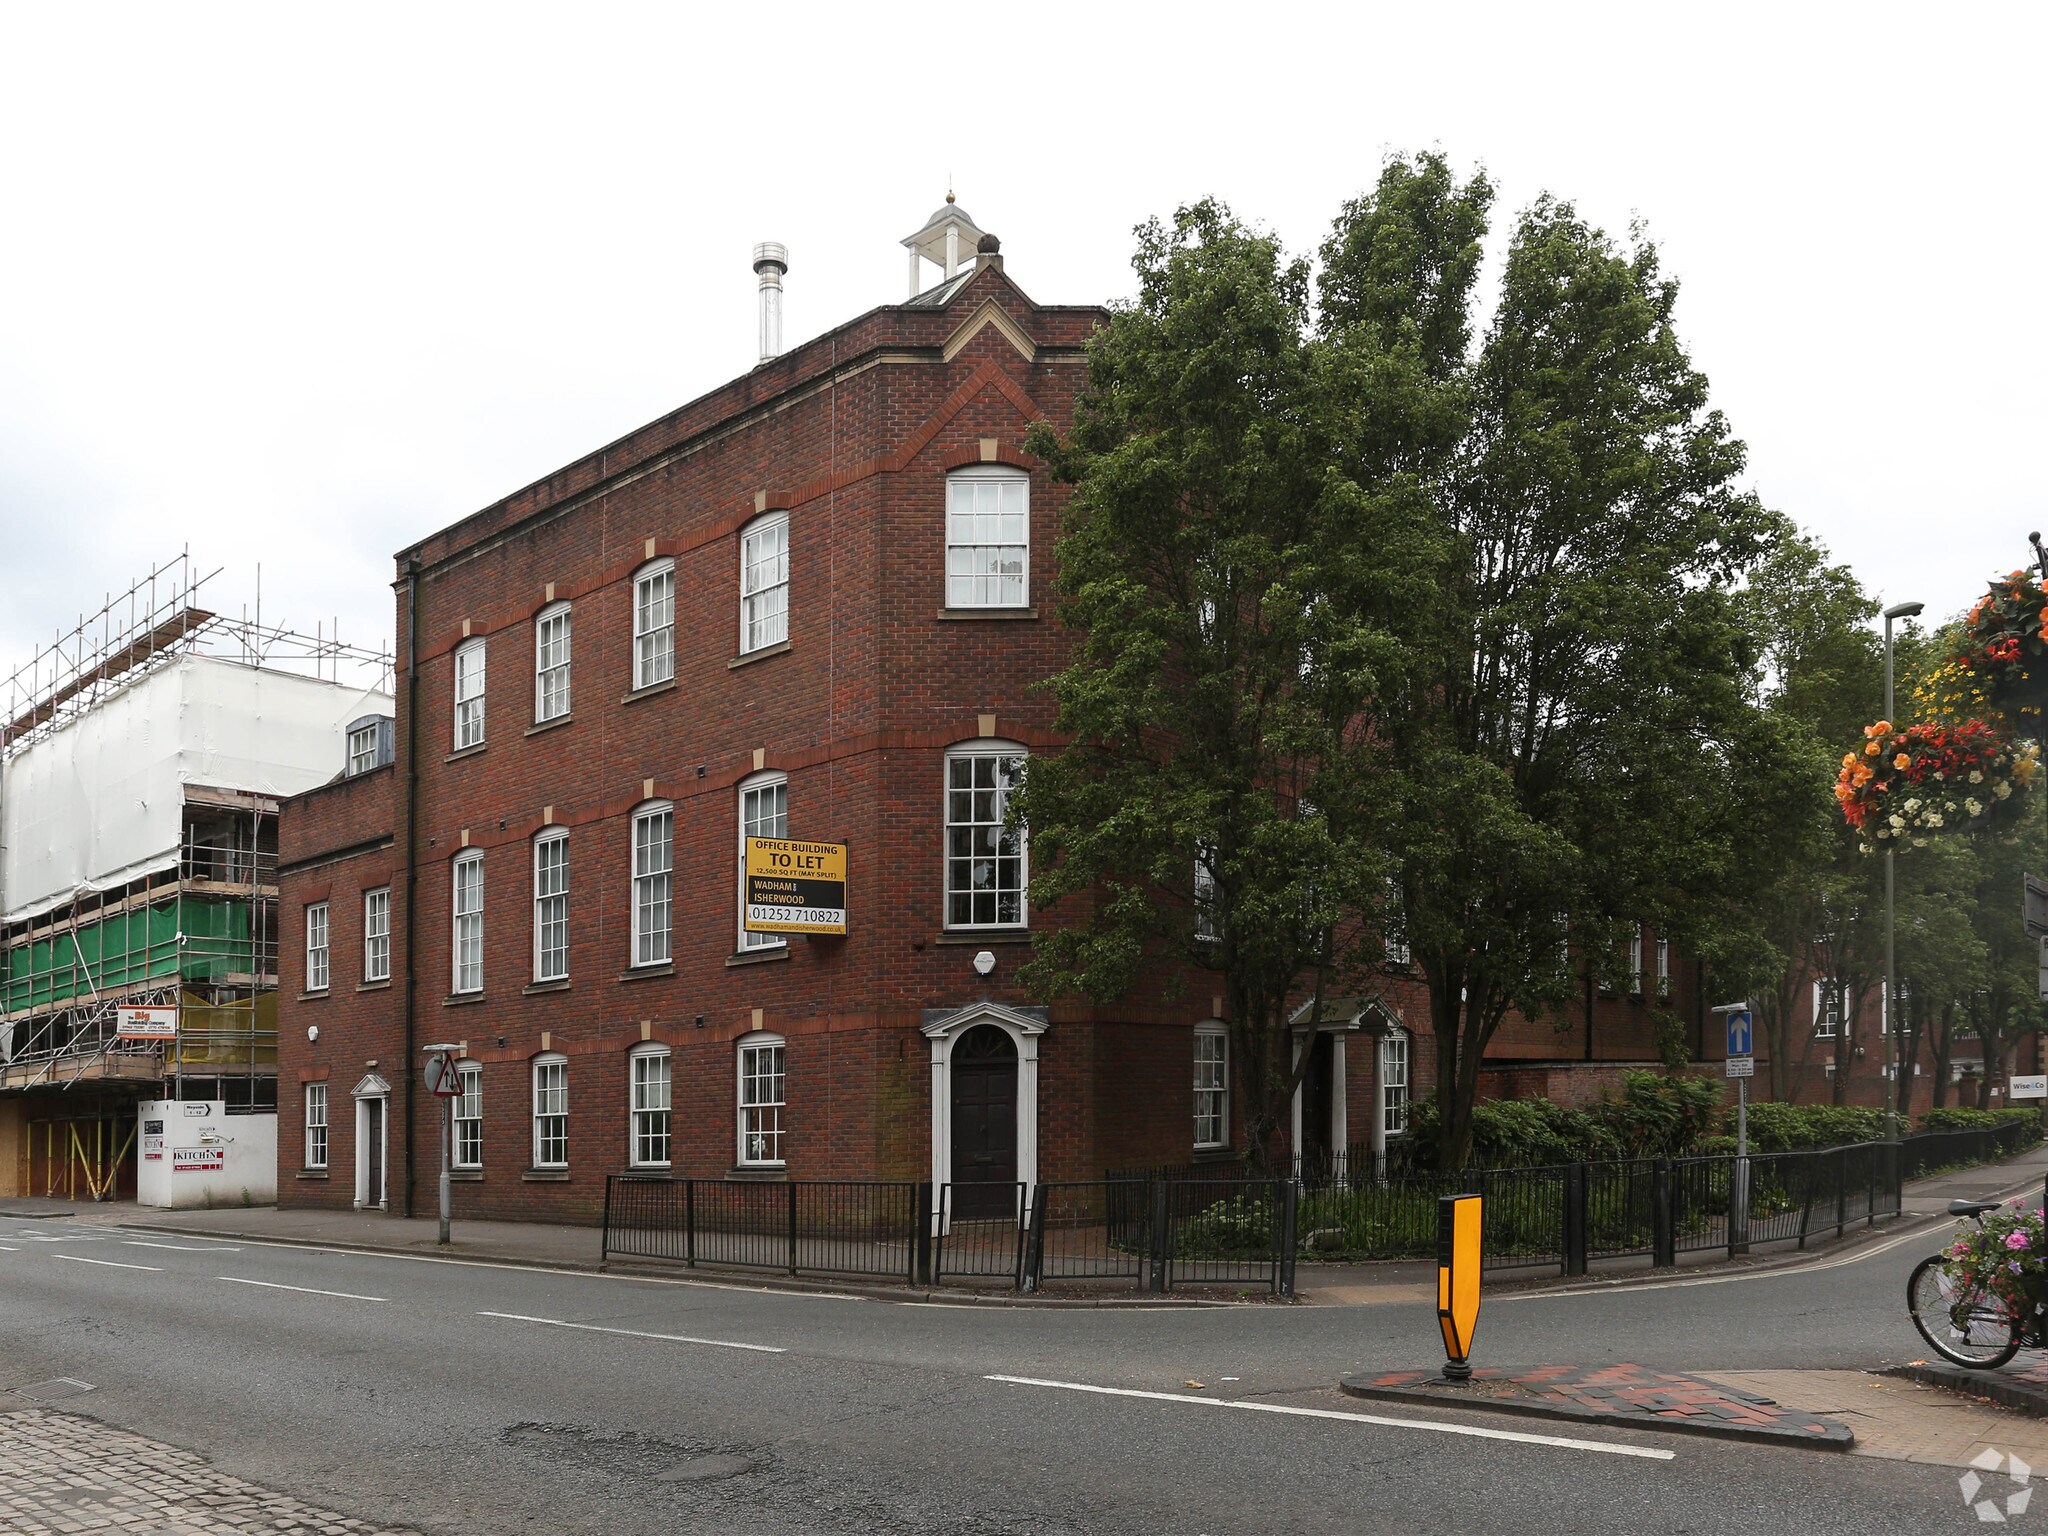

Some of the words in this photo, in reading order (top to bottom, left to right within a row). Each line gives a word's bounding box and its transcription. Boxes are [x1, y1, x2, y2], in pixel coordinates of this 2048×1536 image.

[755, 840, 789, 851] OFFICE
[791, 843, 838, 855] BUILDING
[769, 853, 792, 867] TO
[797, 855, 825, 869] LET
[798, 869, 815, 878] (MAY
[816, 871, 837, 879] SPLIT)
[754, 880, 792, 891] WADHAM
[754, 893, 805, 904] ISHERWOOD
[752, 907, 791, 921] 01252
[795, 909, 840, 923] 710822
[750, 923, 842, 933] www.wadhamandisherwood.co.uk
[134, 1011, 151, 1021] Big
